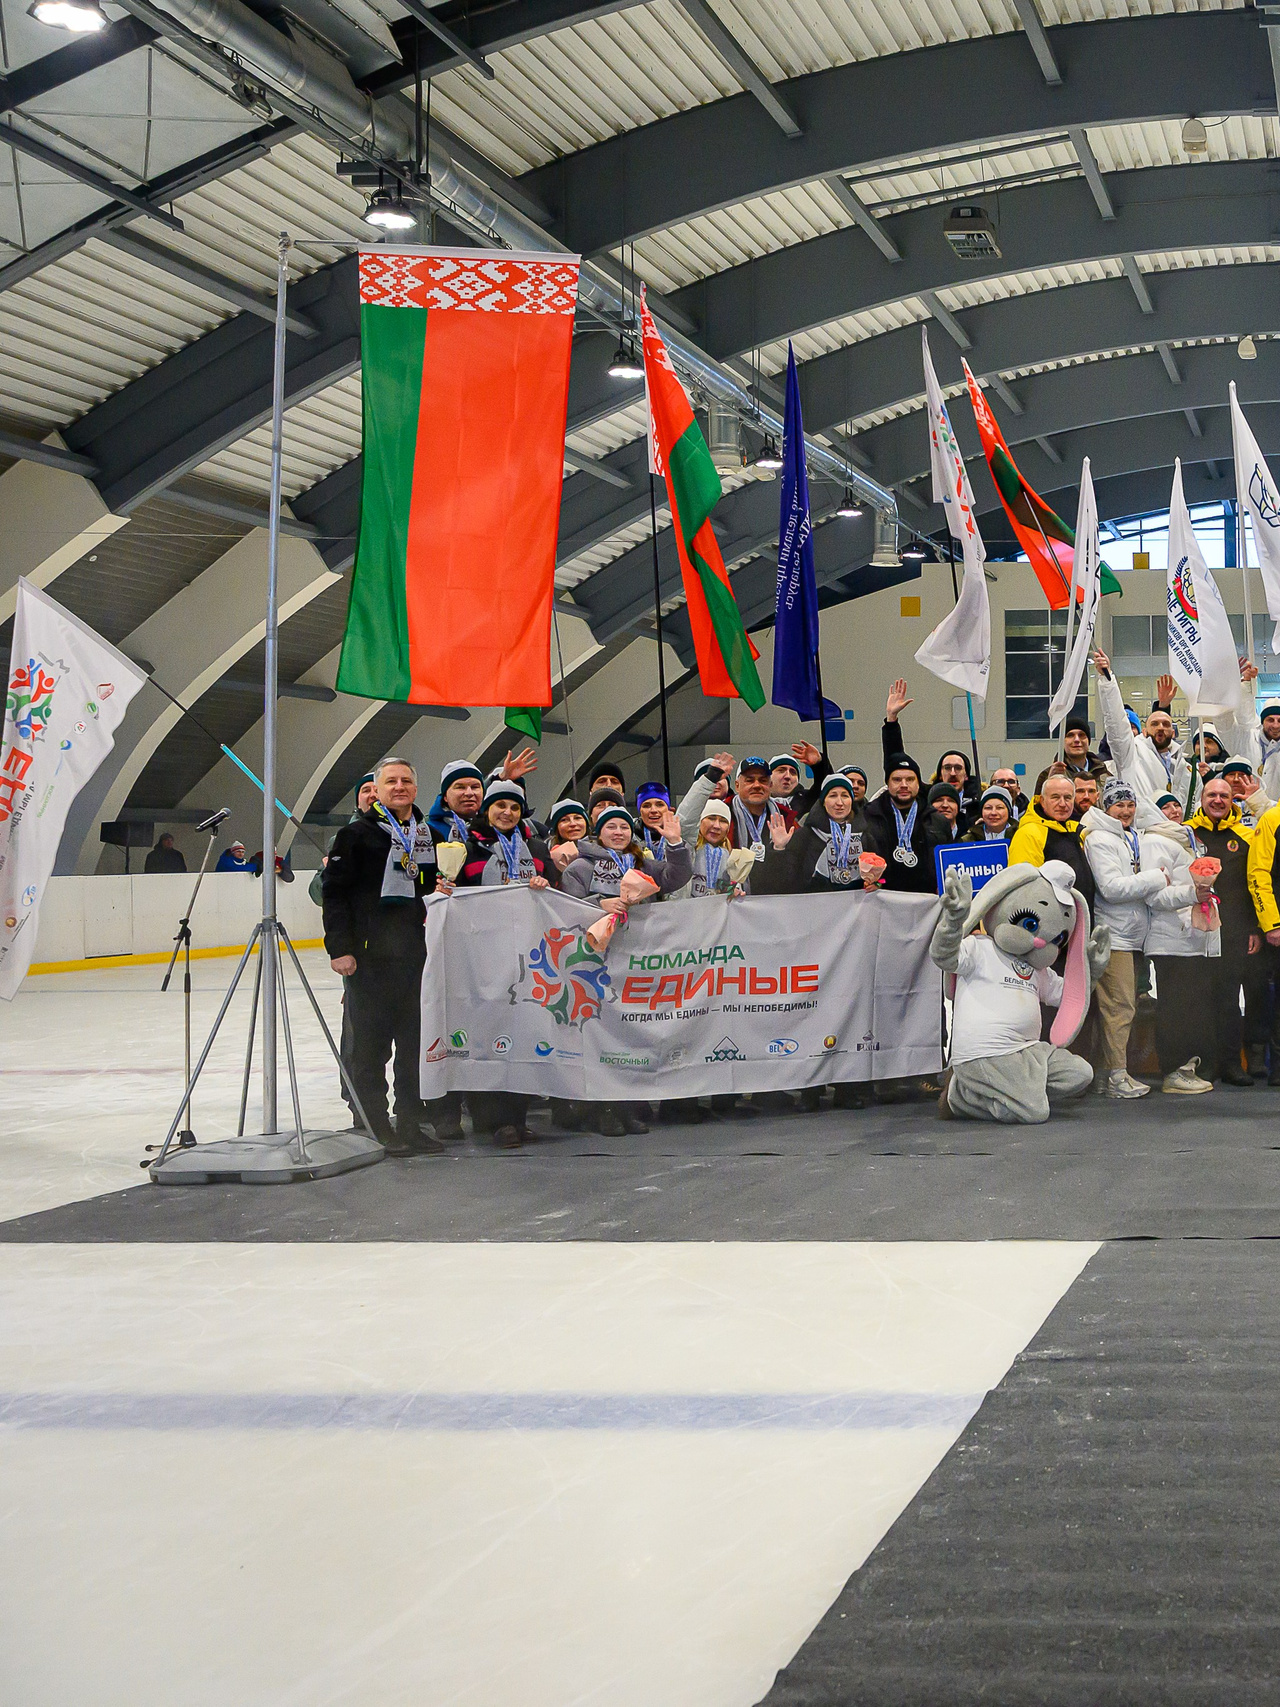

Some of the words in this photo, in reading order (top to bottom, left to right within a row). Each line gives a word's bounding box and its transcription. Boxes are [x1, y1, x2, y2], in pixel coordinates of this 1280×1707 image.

[1175, 610, 1202, 646] ТИГРЫ
[1176, 649, 1194, 676] ОТДЫХА
[629, 944, 745, 971] КОМАНДА
[621, 964, 820, 1011] ЕДИНЫЕ
[1004, 976, 1025, 986] БЕЛЫЕ
[621, 1012, 653, 1023] КОГДА
[655, 1011, 674, 1021] МЫ
[676, 1006, 710, 1020] ЕДИНЫ
[722, 1003, 741, 1013] МЫ
[743, 1000, 819, 1014] НЕПОБЕДИМЫ!
[599, 1056, 650, 1066] ВОСТОЧНЫЙ
